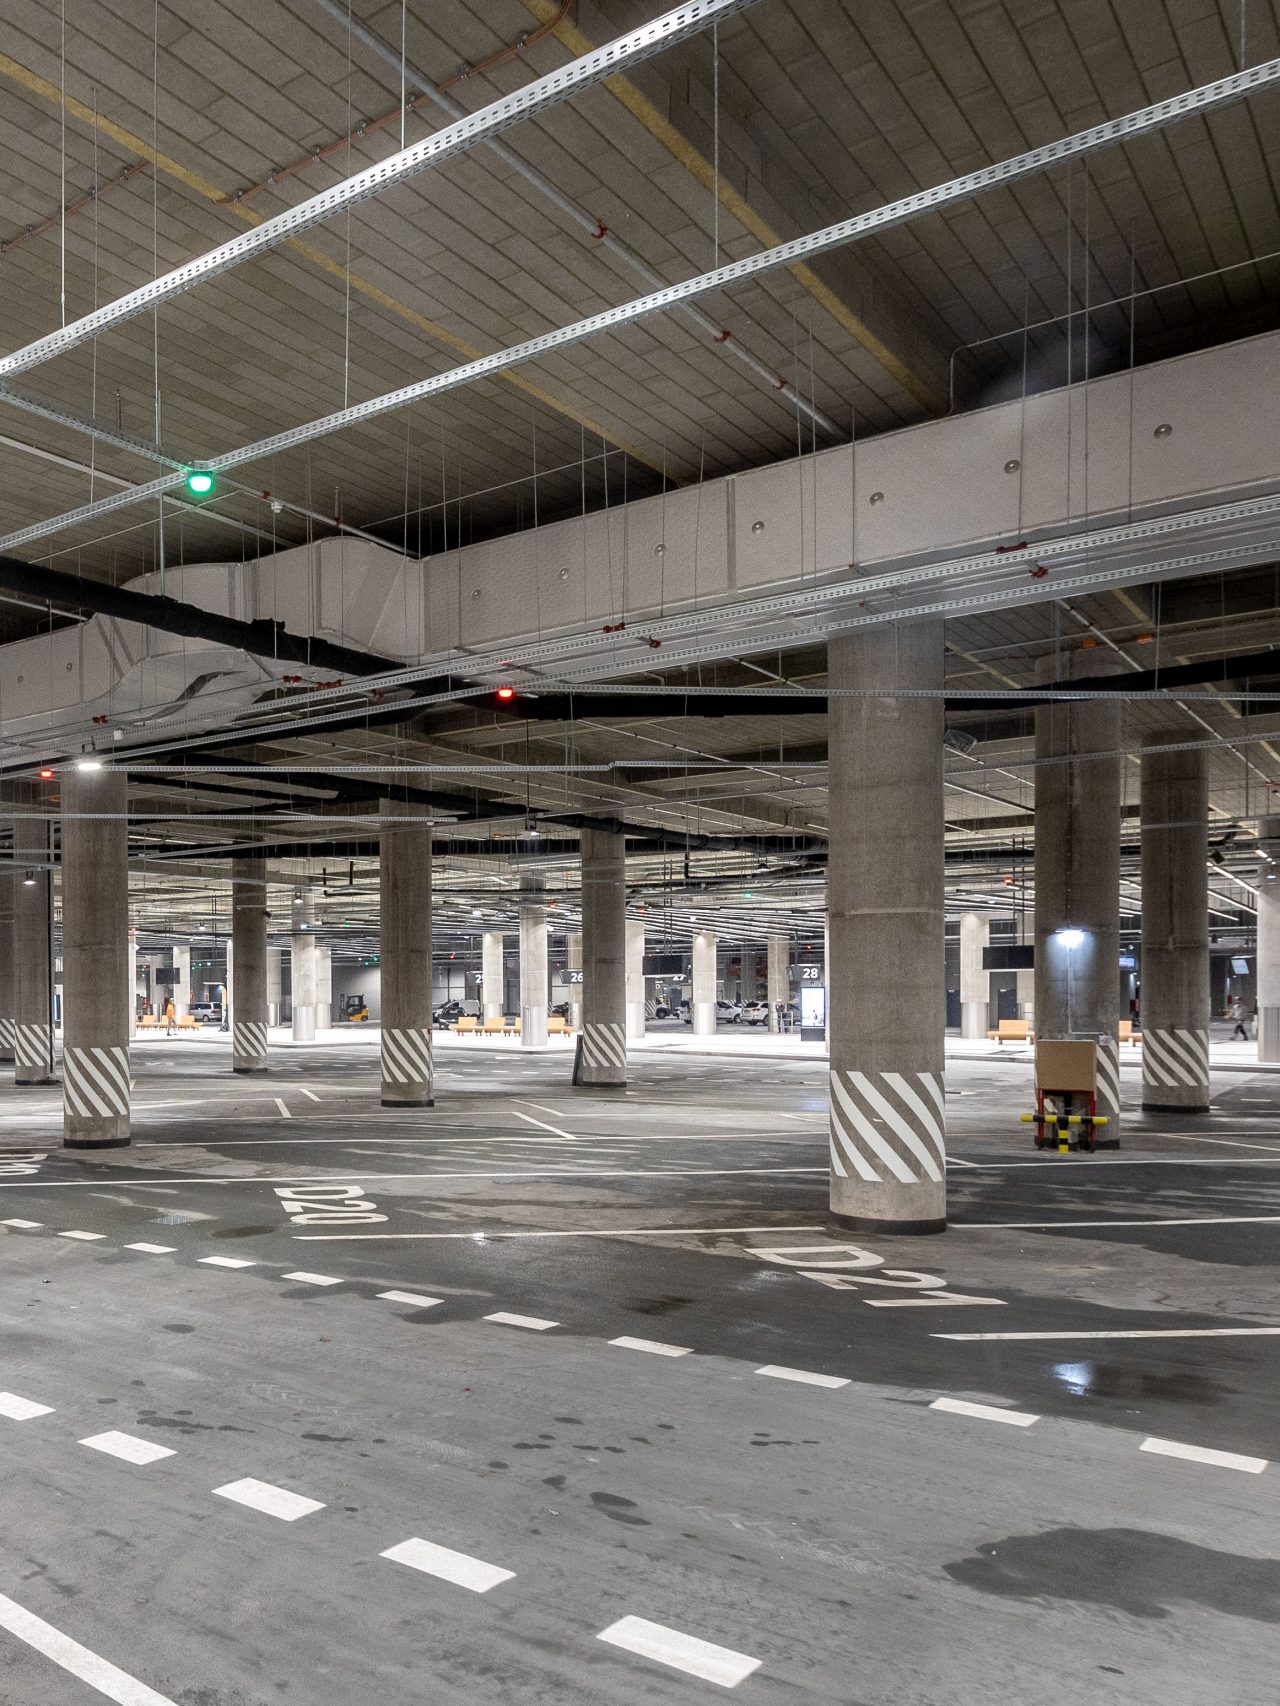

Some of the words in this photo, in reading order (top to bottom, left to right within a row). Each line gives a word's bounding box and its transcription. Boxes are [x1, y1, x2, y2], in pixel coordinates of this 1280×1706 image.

[570, 972, 583, 982] 26
[802, 967, 819, 979] 28
[273, 1186, 390, 1225] D20
[743, 1245, 1009, 1307] D21
